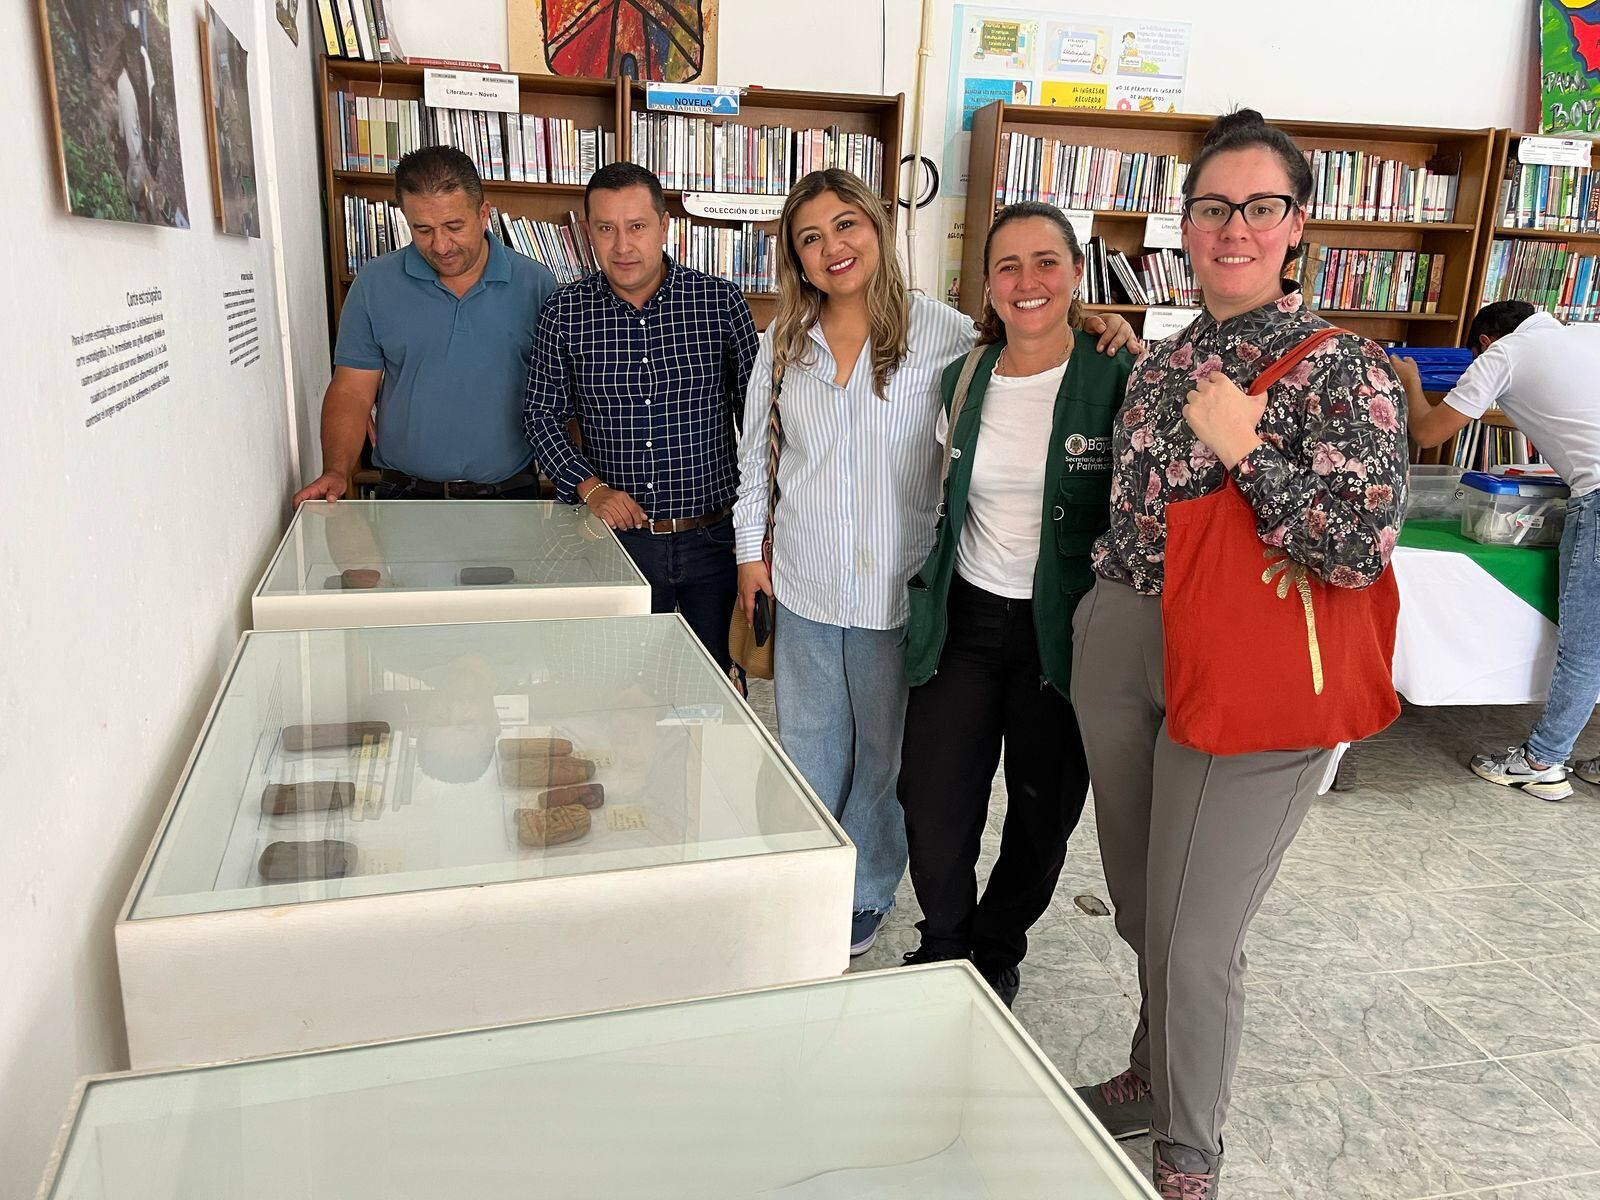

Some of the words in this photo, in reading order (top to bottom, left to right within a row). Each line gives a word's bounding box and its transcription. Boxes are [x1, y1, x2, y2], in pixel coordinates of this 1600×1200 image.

[446, 89, 473, 97] Literatura
[674, 97, 712, 107] NOVELA
[679, 105, 713, 113] ADULTOS
[1069, 464, 1075, 473] y
